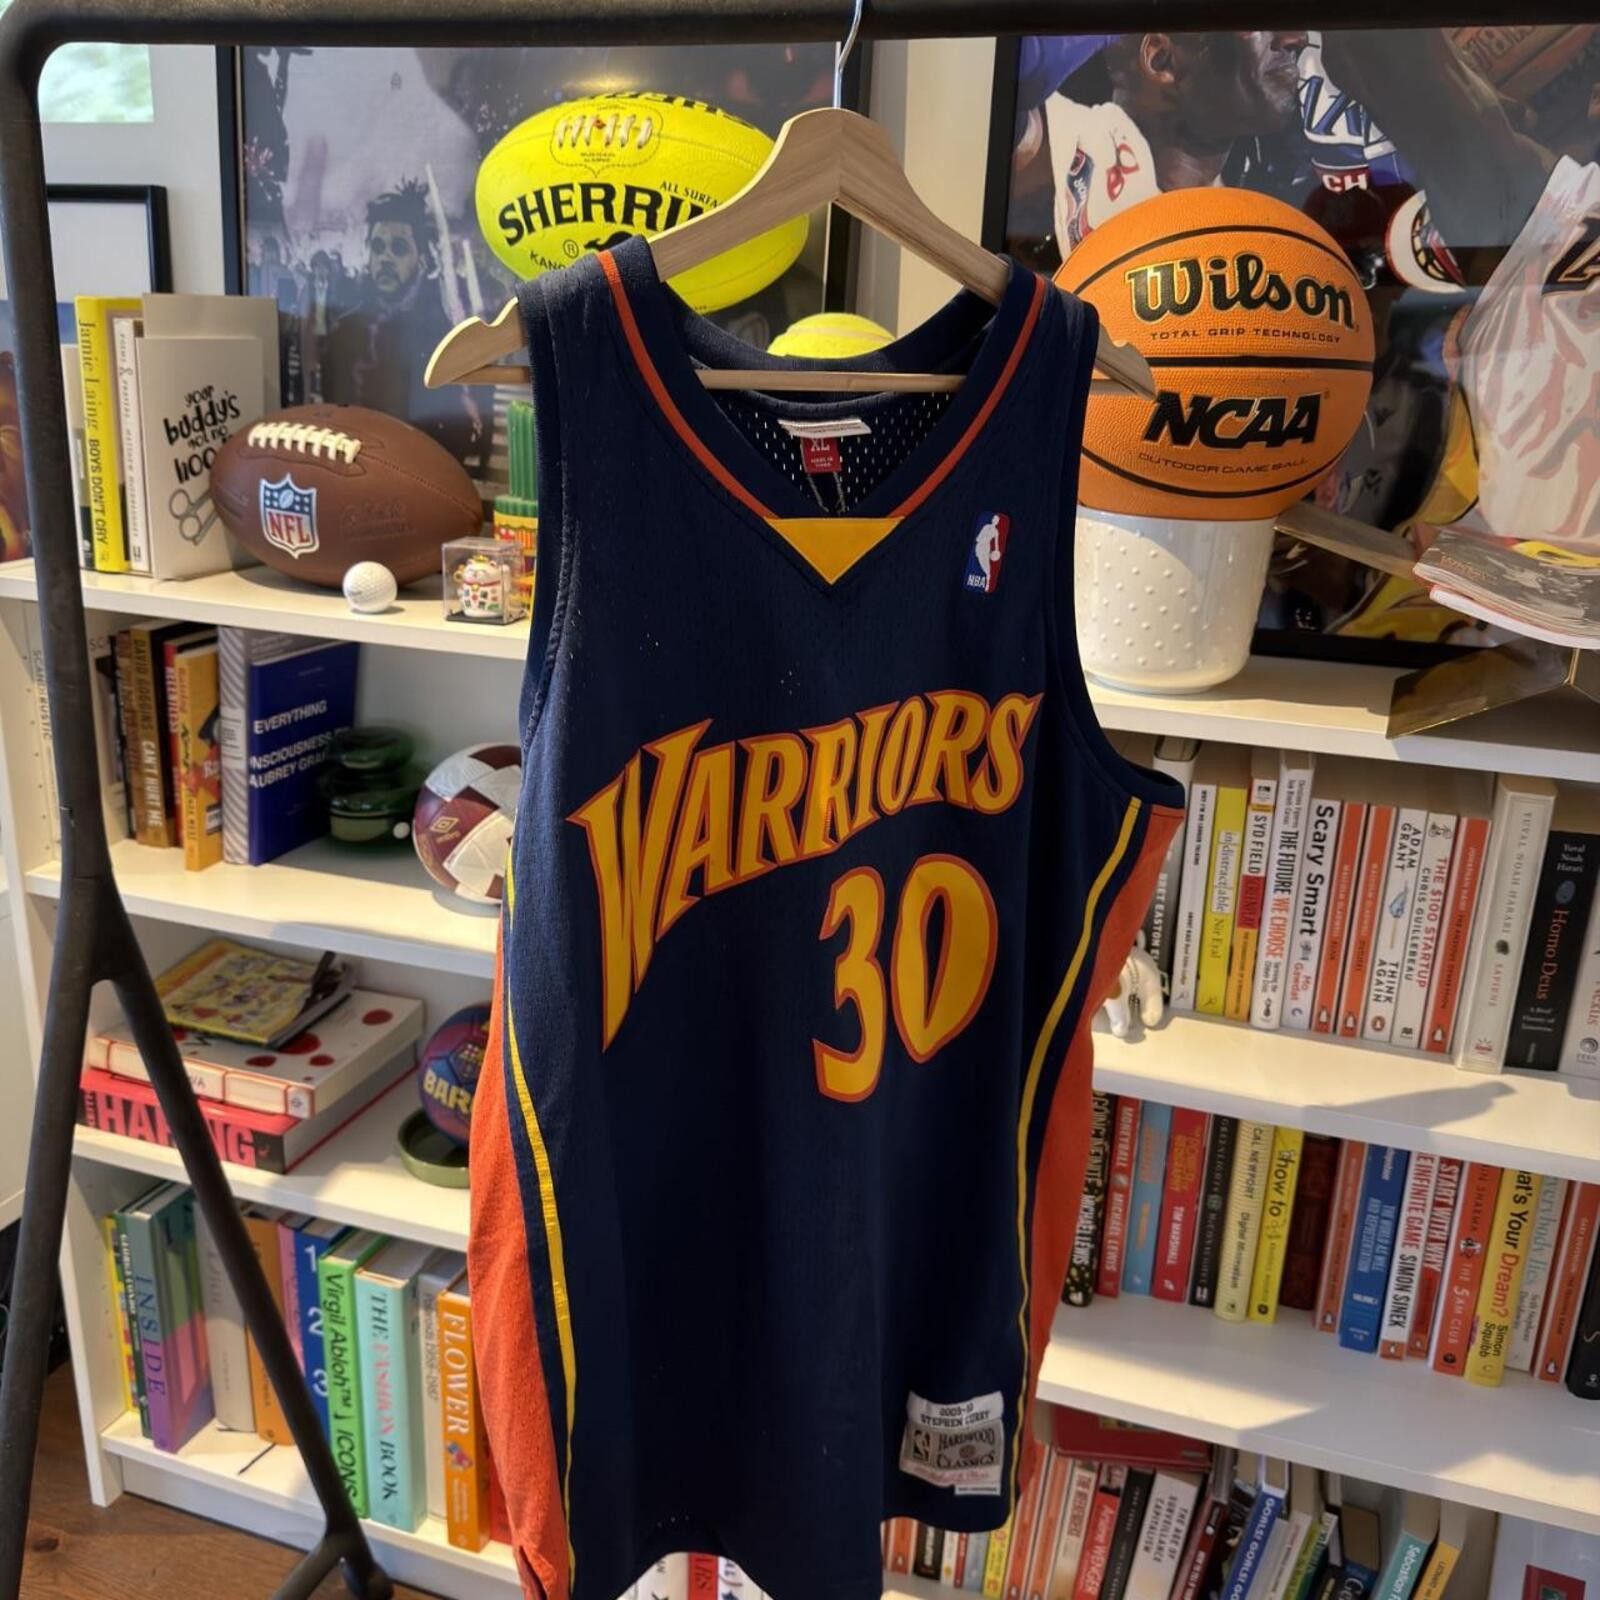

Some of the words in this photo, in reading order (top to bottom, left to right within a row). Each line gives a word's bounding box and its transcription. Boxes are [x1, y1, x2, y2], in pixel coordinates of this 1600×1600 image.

[659, 180, 681, 195] ALL
[1125, 252, 1357, 331] Wilson
[78, 319, 98, 372] Jamie
[1150, 329, 1199, 341] TOTAL
[1207, 327, 1246, 337] GRIP
[1252, 327, 1342, 343] TECHNOLOGY
[184, 385, 214, 408] your
[163, 390, 240, 446] buddy's
[1142, 390, 1323, 450] NCAA
[88, 438, 102, 474] BOYS
[1138, 452, 1220, 474] OUTDOOR
[1222, 463, 1270, 474] GAME
[1272, 457, 1309, 471] BALL
[91, 475, 106, 514] DON'T
[96, 517, 110, 546] CRY
[267, 511, 310, 545] NFL
[966, 574, 986, 588] NBA
[253, 700, 327, 735] EVERYTHING
[141, 740, 158, 774] CAN'T
[249, 760, 297, 789] AUBREY
[144, 776, 160, 807] HURT
[148, 809, 164, 827] ME
[1254, 814, 1268, 838] SYD
[1306, 805, 1335, 867] Scary
[1517, 811, 1533, 849] YUVAL
[1248, 838, 1264, 874] FIELD
[1280, 830, 1299, 851] THE
[1394, 822, 1413, 872] GRANT
[1406, 826, 1422, 869] ADAM
[565, 688, 1045, 1054] WARRIORS
[1273, 851, 1296, 895] FUTURE
[1417, 867, 1431, 904] CHRIS
[1433, 856, 1447, 884] THE
[1511, 853, 1525, 886] NOAH
[1152, 902, 1165, 947] EASTON
[1271, 896, 1289, 915] WE
[1298, 872, 1326, 938] Smart
[1426, 888, 1442, 922] $100
[1502, 889, 1519, 934] HARARI
[1214, 917, 1225, 935] Nir
[1265, 915, 1287, 960] CHOOSE
[1404, 907, 1424, 982] GUILLEBEAU
[1545, 908, 1569, 959] Homo
[1211, 935, 1222, 958] Eyal
[1415, 925, 1436, 989] STARTUP
[811, 852, 999, 1103] 30
[1290, 962, 1304, 1001] Gawdat
[1301, 975, 1312, 991] Mo
[1373, 958, 1386, 1003] AGAIN
[1383, 960, 1400, 1005] THINK
[1488, 963, 1504, 1007] SAPIENS
[1535, 961, 1558, 1001] Deus
[98, 1090, 256, 1170] HANG
[1116, 1106, 1135, 1169] MONEYBALL
[1252, 1127, 1264, 1146] CAL
[1244, 1149, 1260, 1200] NEWPORT
[1273, 1155, 1297, 1196] how
[1407, 1163, 1433, 1213] INFINITE
[1434, 1162, 1460, 1206] START
[1512, 1170, 1535, 1205] at's
[1075, 1193, 1097, 1234] MICHAEL
[1108, 1191, 1125, 1237] MICHAEL
[1238, 1211, 1251, 1241] Digital
[1269, 1199, 1288, 1218] to
[1428, 1205, 1453, 1241] WITH
[1471, 1186, 1487, 1233] SHARMA
[1402, 1216, 1424, 1251] GAME
[1505, 1208, 1530, 1250] Your
[1072, 1234, 1095, 1266] LEWIS
[1105, 1238, 1120, 1273] LEWIS
[1423, 1241, 1446, 1272] WHY
[1394, 1253, 1418, 1292] SIMON
[1458, 1262, 1473, 1282] THE
[1490, 1251, 1521, 1319] Dream?
[323, 1273, 348, 1326] Virgil
[370, 1293, 390, 1341] THE
[1390, 1293, 1411, 1329] SINEK
[135, 1276, 166, 1396] INSIDE
[308, 1306, 323, 1335] 2
[1447, 1317, 1461, 1345] CLUB
[1479, 1320, 1497, 1359] Squibb
[1492, 1323, 1509, 1358] Simon
[313, 1368, 329, 1397] 3
[442, 1311, 470, 1436] FLOWER
[920, 1413, 963, 1428] STEPHEN
[964, 1409, 991, 1425] CURRY
[379, 1439, 399, 1502] BOOK
[1176, 1507, 1189, 1526] THE
[1253, 1497, 1275, 1540] GOALS!
[1084, 1544, 1108, 1597] WENGER
[1237, 1541, 1259, 1583] GOALS!
